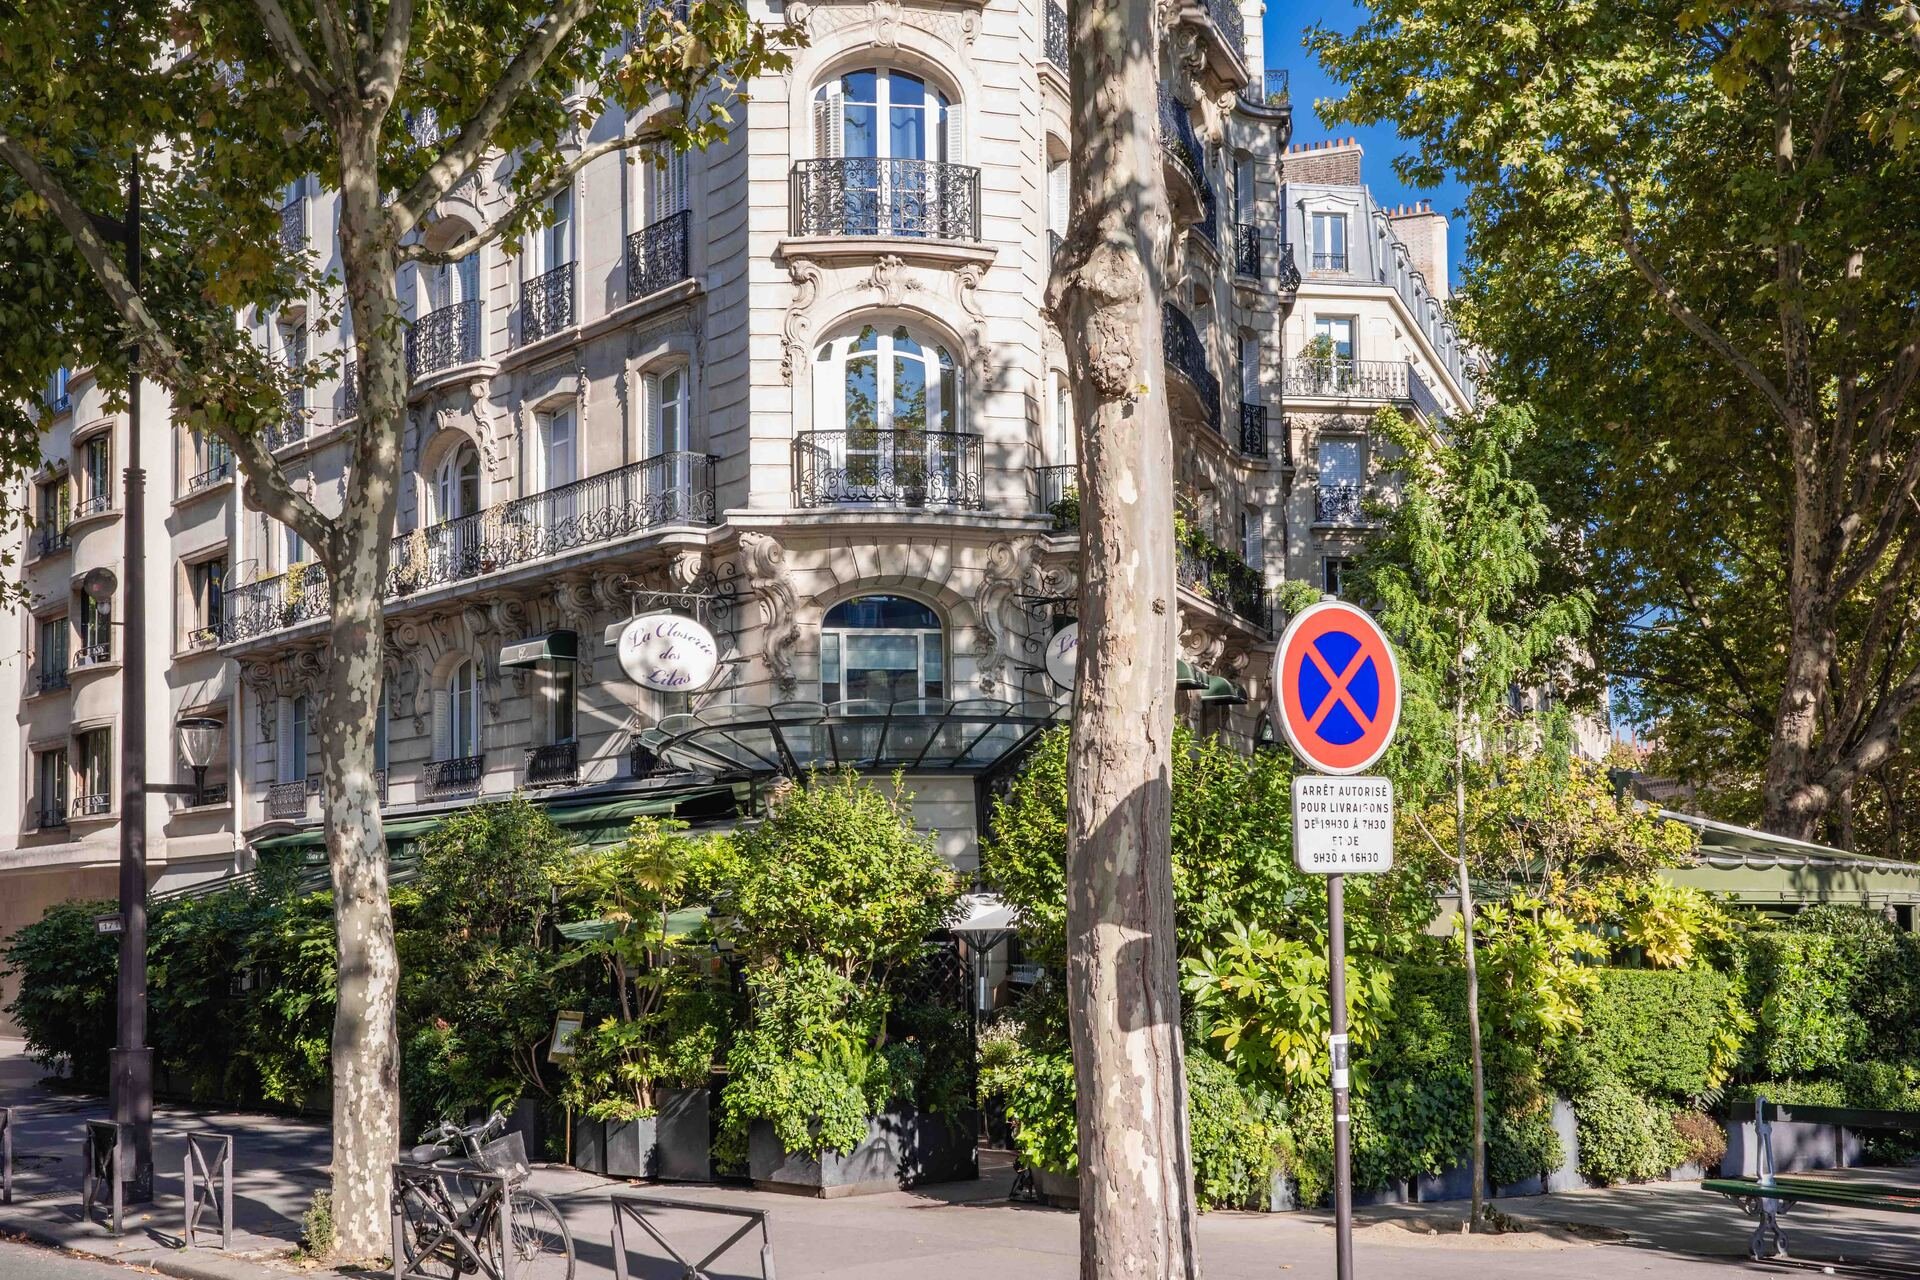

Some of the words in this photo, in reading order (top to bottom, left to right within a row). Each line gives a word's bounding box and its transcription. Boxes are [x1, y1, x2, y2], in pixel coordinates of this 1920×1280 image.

[628, 627, 652, 649] La
[645, 666, 691, 687] Lilas
[1302, 784, 1334, 796] ARRÊT
[1338, 785, 1387, 797] AUTORISÉ
[1300, 802, 1327, 813] POUR
[1304, 819, 1316, 829] DE
[1321, 819, 1349, 829] 19H30
[1362, 820, 1386, 830] 7H30
[1332, 836, 1343, 846] ET
[1347, 836, 1359, 846] DE
[1313, 852, 1337, 863] 9H30
[1350, 852, 1379, 863] 16H30
